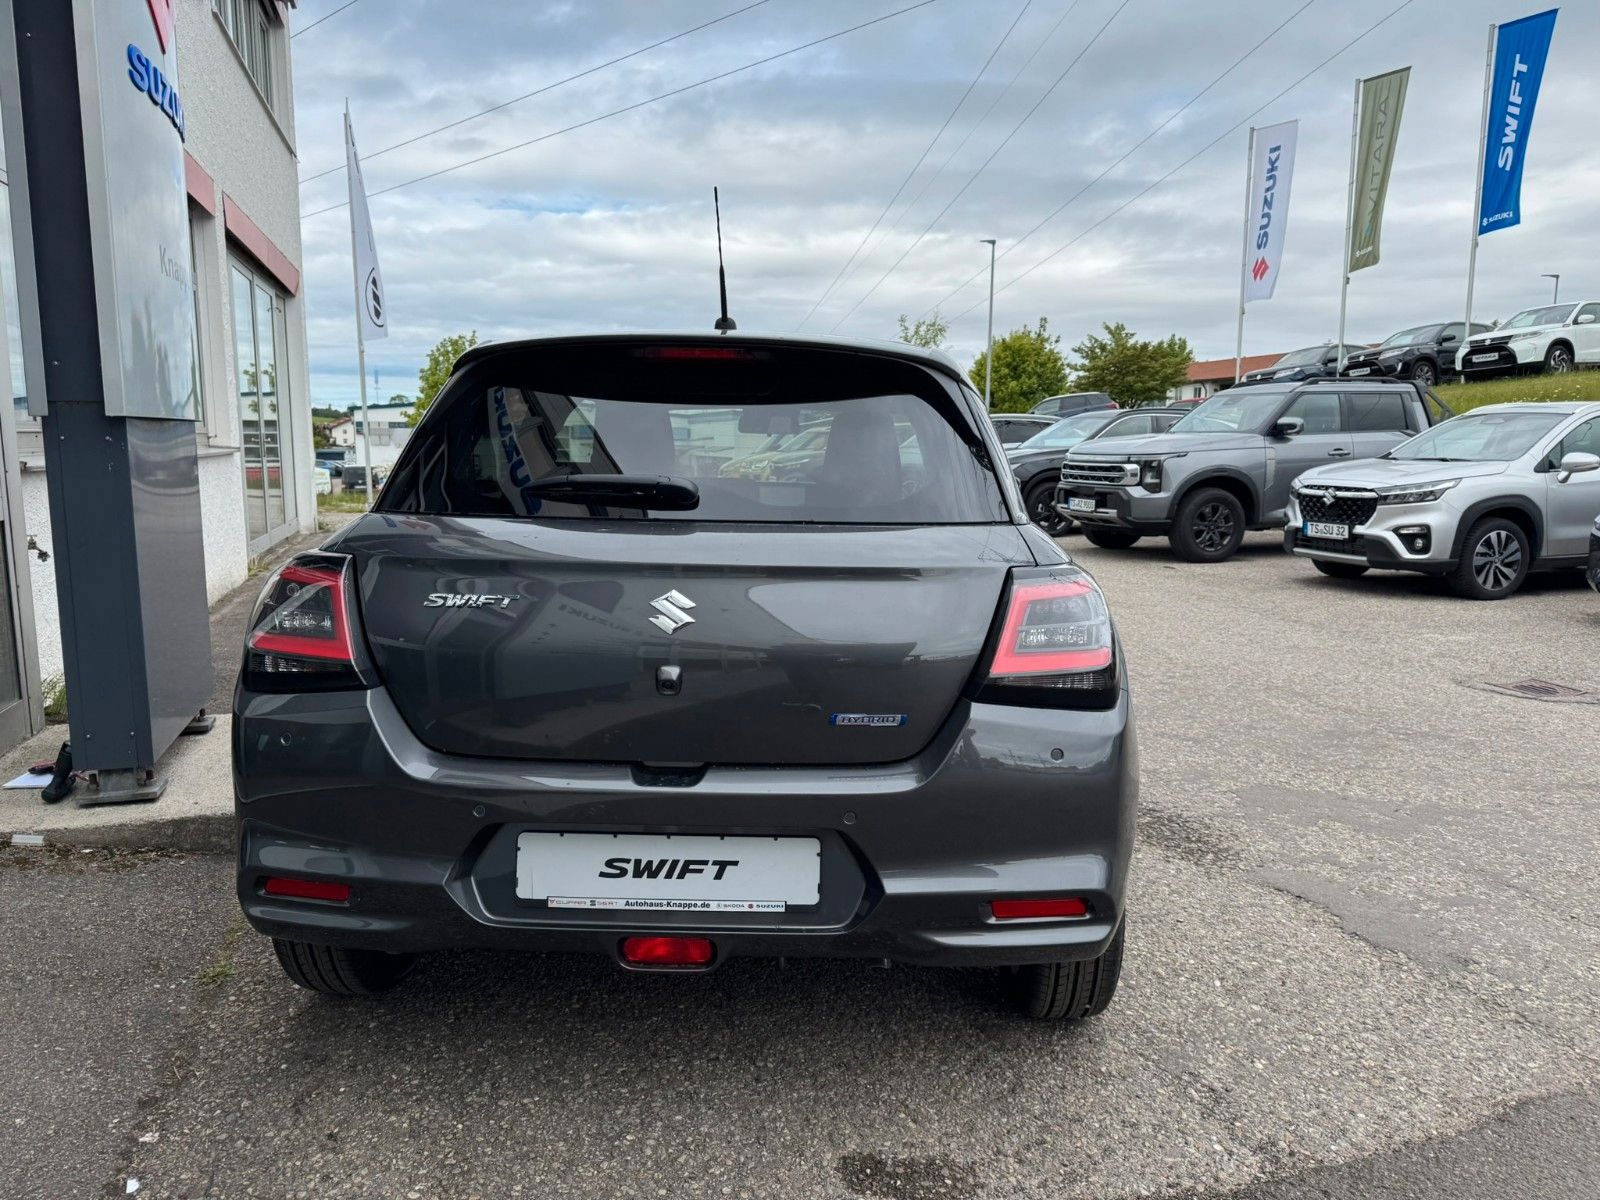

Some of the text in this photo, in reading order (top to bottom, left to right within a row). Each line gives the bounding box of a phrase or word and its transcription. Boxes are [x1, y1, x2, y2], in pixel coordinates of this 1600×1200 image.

[1498, 53, 1528, 171] SWIFT
[1368, 94, 1390, 217] VITARA
[1256, 144, 1281, 250] SUZUKI
[1310, 523, 1346, 537] TS SU 32
[424, 592, 520, 609] SWIFT
[838, 715, 898, 724] HYBRID
[598, 857, 740, 881] SWIFT
[624, 900, 711, 910] Autohaus-Knappe.de
